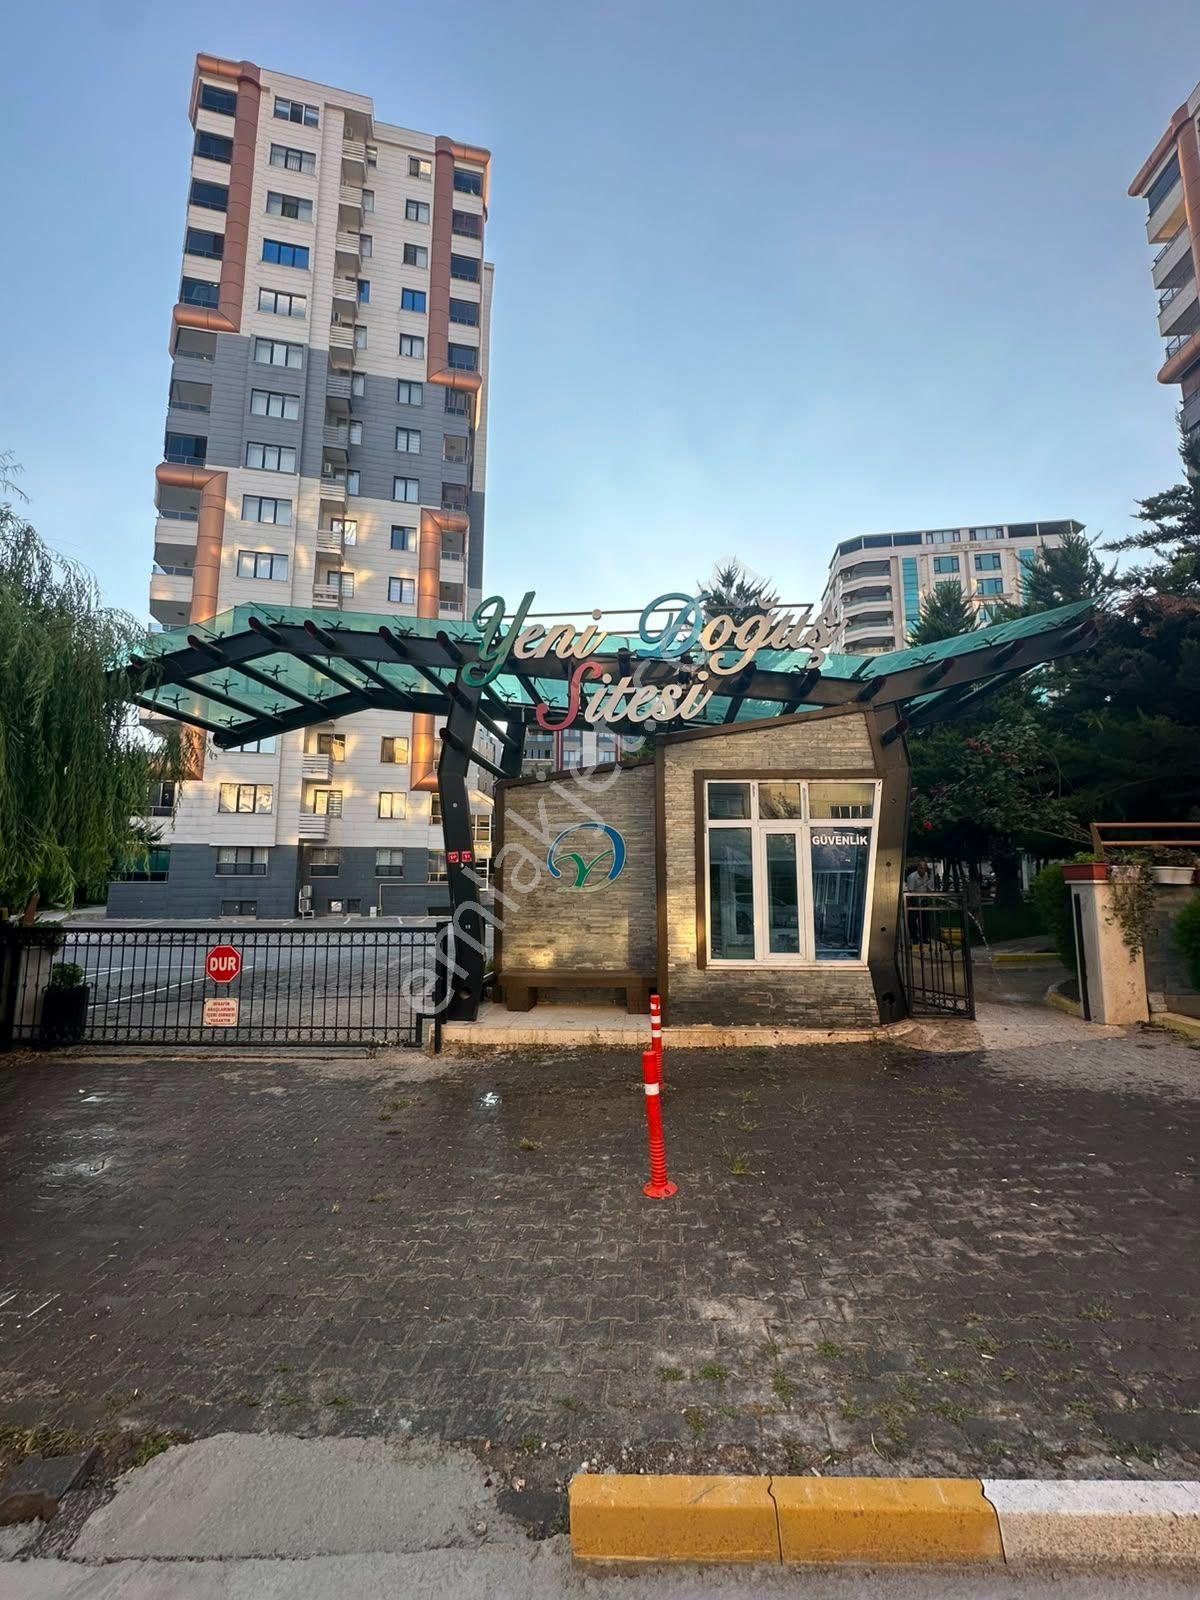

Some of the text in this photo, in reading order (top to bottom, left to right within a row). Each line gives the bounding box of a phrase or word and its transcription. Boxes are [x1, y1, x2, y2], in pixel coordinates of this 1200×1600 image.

[461, 590, 848, 688] Yeni Doğuş
[535, 661, 714, 731] Sitesi
[811, 833, 868, 846] GÜVENLİK
[209, 957, 237, 971] DUR
